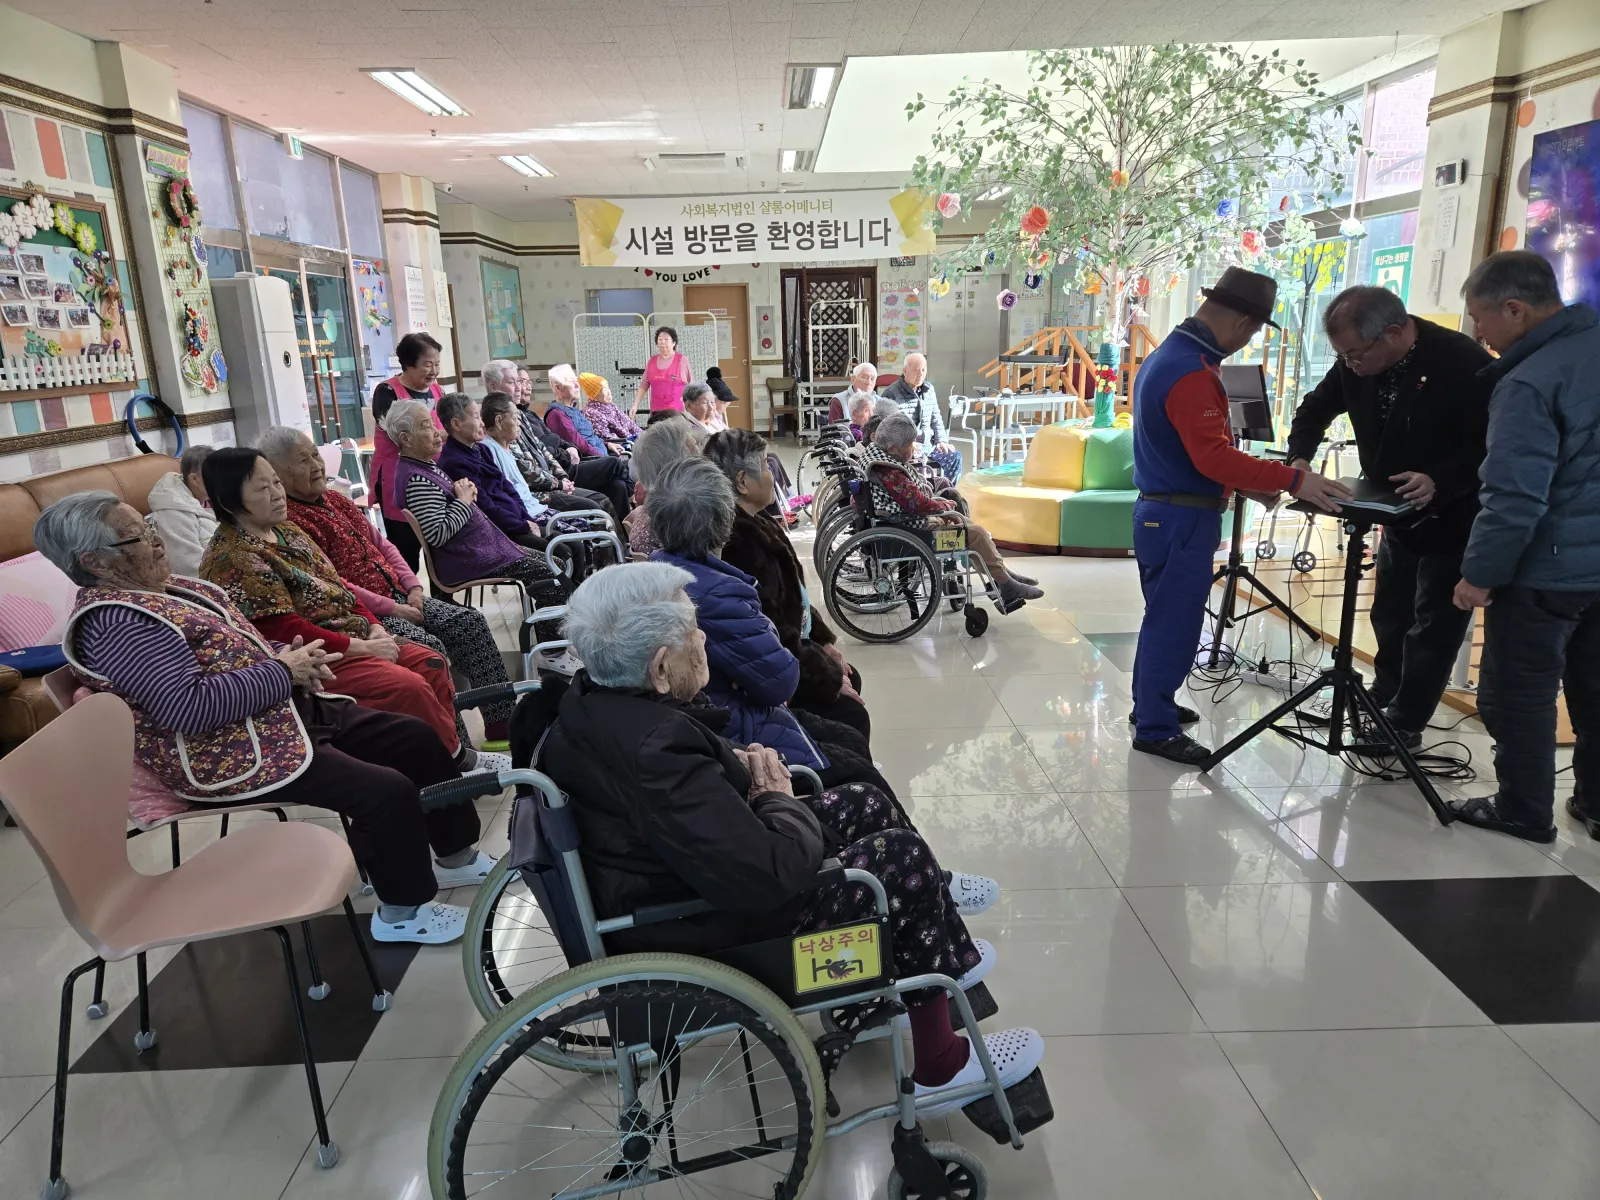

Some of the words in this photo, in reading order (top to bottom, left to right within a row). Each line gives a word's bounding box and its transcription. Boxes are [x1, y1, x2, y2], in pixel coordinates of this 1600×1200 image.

[680, 200, 755, 219] 사회복지법인
[759, 198, 833, 215] 샬롬어메니티
[625, 226, 674, 255] 시설
[684, 222, 758, 255] 방문을
[767, 217, 892, 251] 환영합니다
[655, 271, 677, 282] YOU
[682, 267, 711, 282] LOVE
[799, 928, 874, 955] 낙상주의
